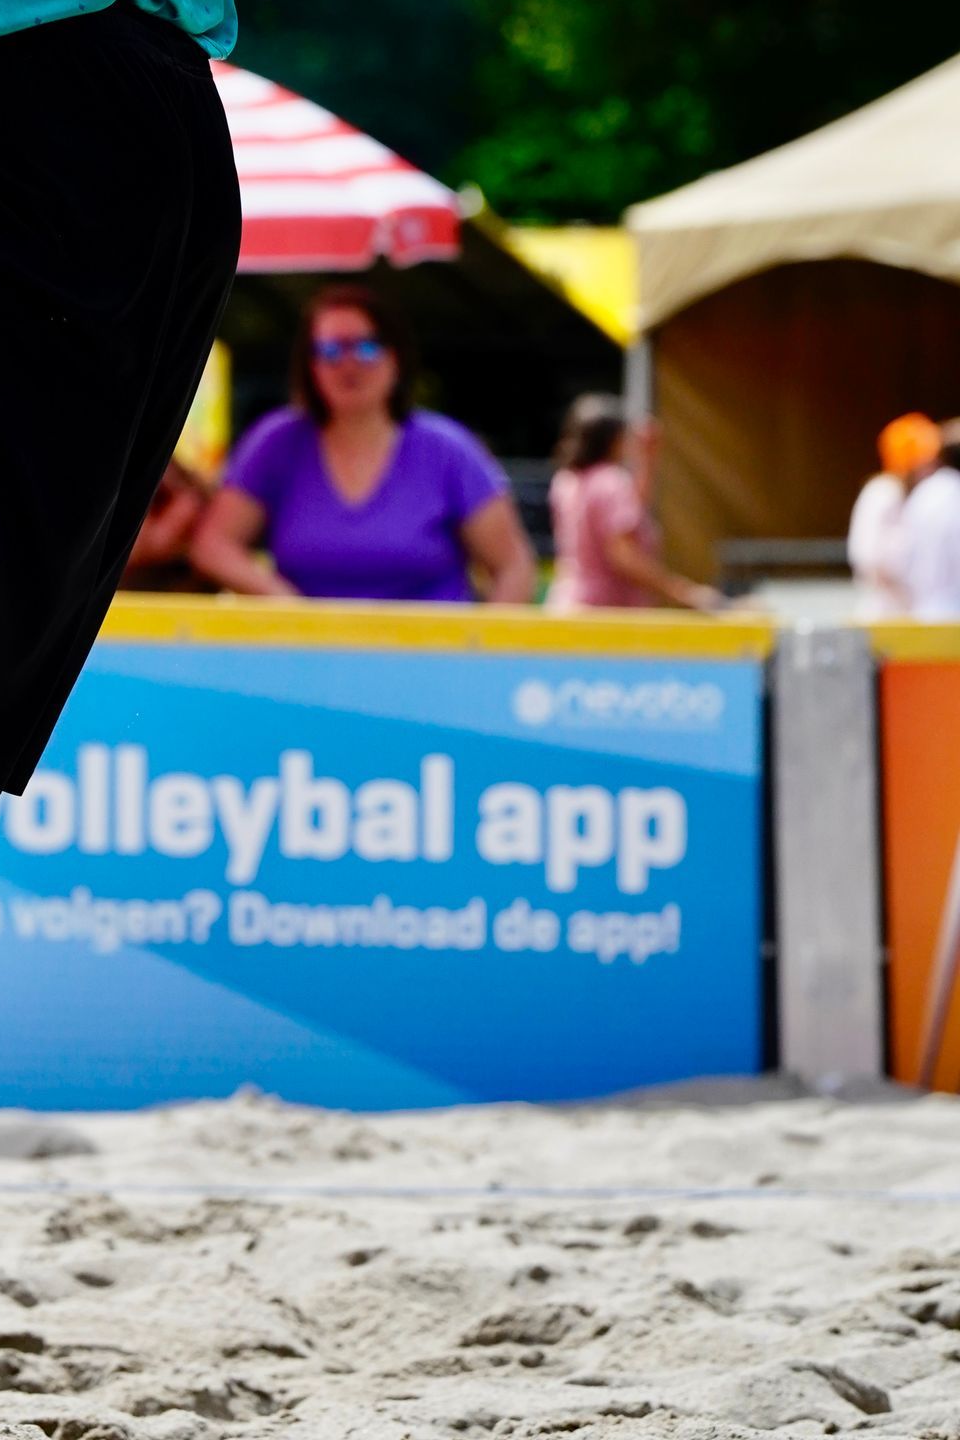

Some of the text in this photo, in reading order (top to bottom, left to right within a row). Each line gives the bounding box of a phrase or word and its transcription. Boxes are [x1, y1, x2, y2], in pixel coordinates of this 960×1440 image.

[476, 779, 690, 895] app
[9, 885, 224, 955] volgen?
[228, 888, 488, 952] Download
[493, 896, 562, 952] de
[565, 901, 683, 963] app!
